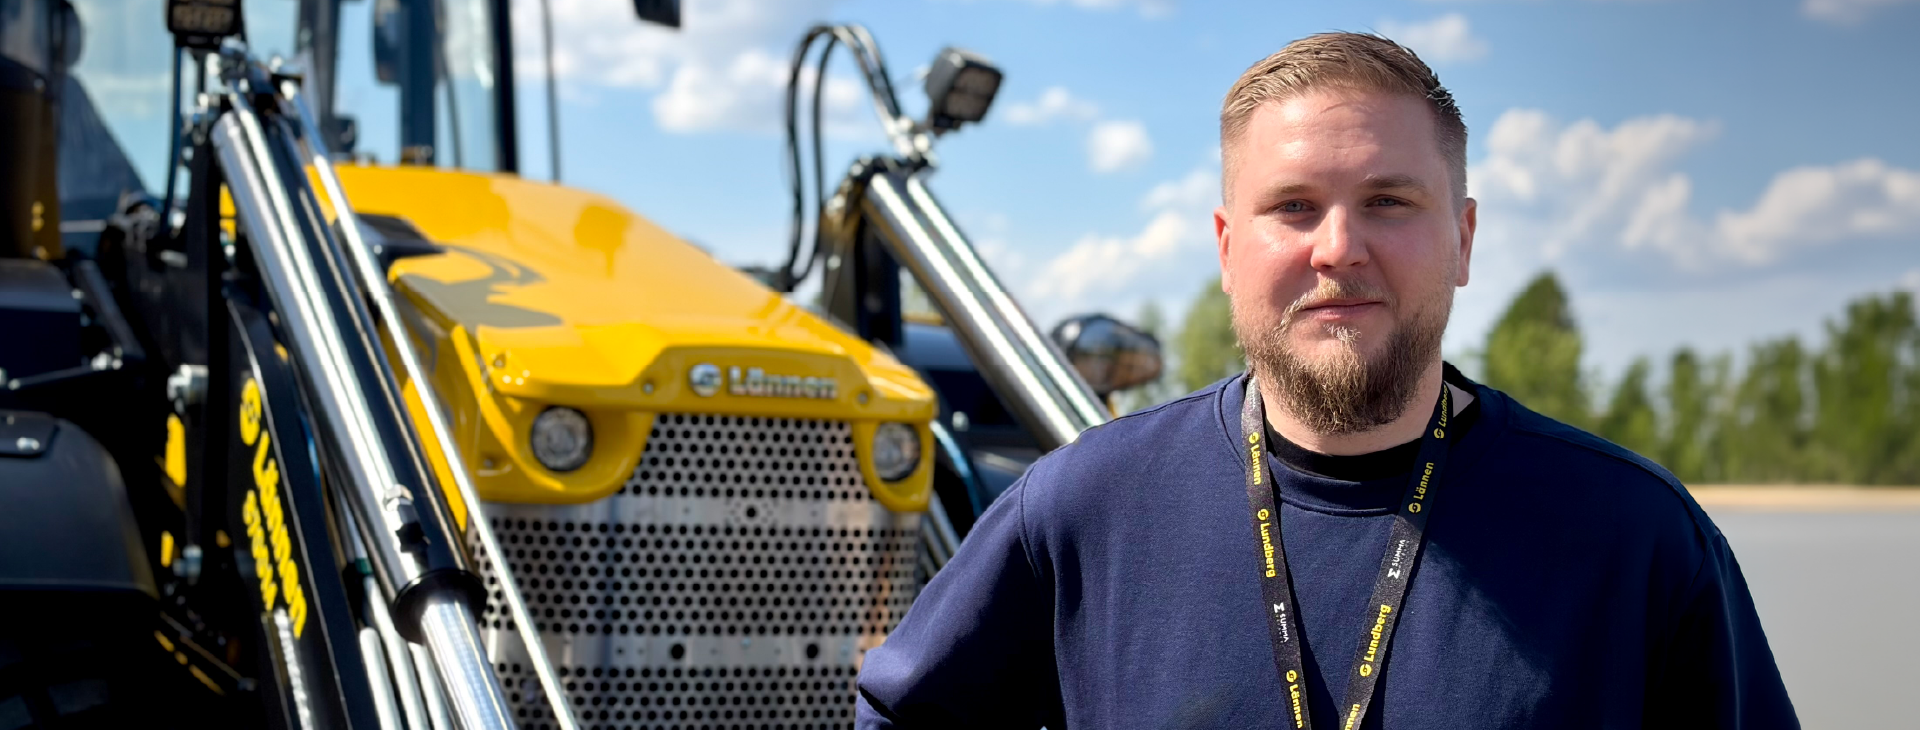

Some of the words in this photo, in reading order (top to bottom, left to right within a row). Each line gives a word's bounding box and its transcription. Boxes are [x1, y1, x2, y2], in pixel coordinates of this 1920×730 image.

[729, 365, 838, 399] Lännen
[1250, 443, 1262, 486] Lännen
[1413, 461, 1434, 500] Lännen
[253, 430, 307, 640] Lännen
[1260, 522, 1276, 578] Lundberg
[1363, 604, 1391, 662] Lundberg
[1289, 683, 1303, 729] Lännen
